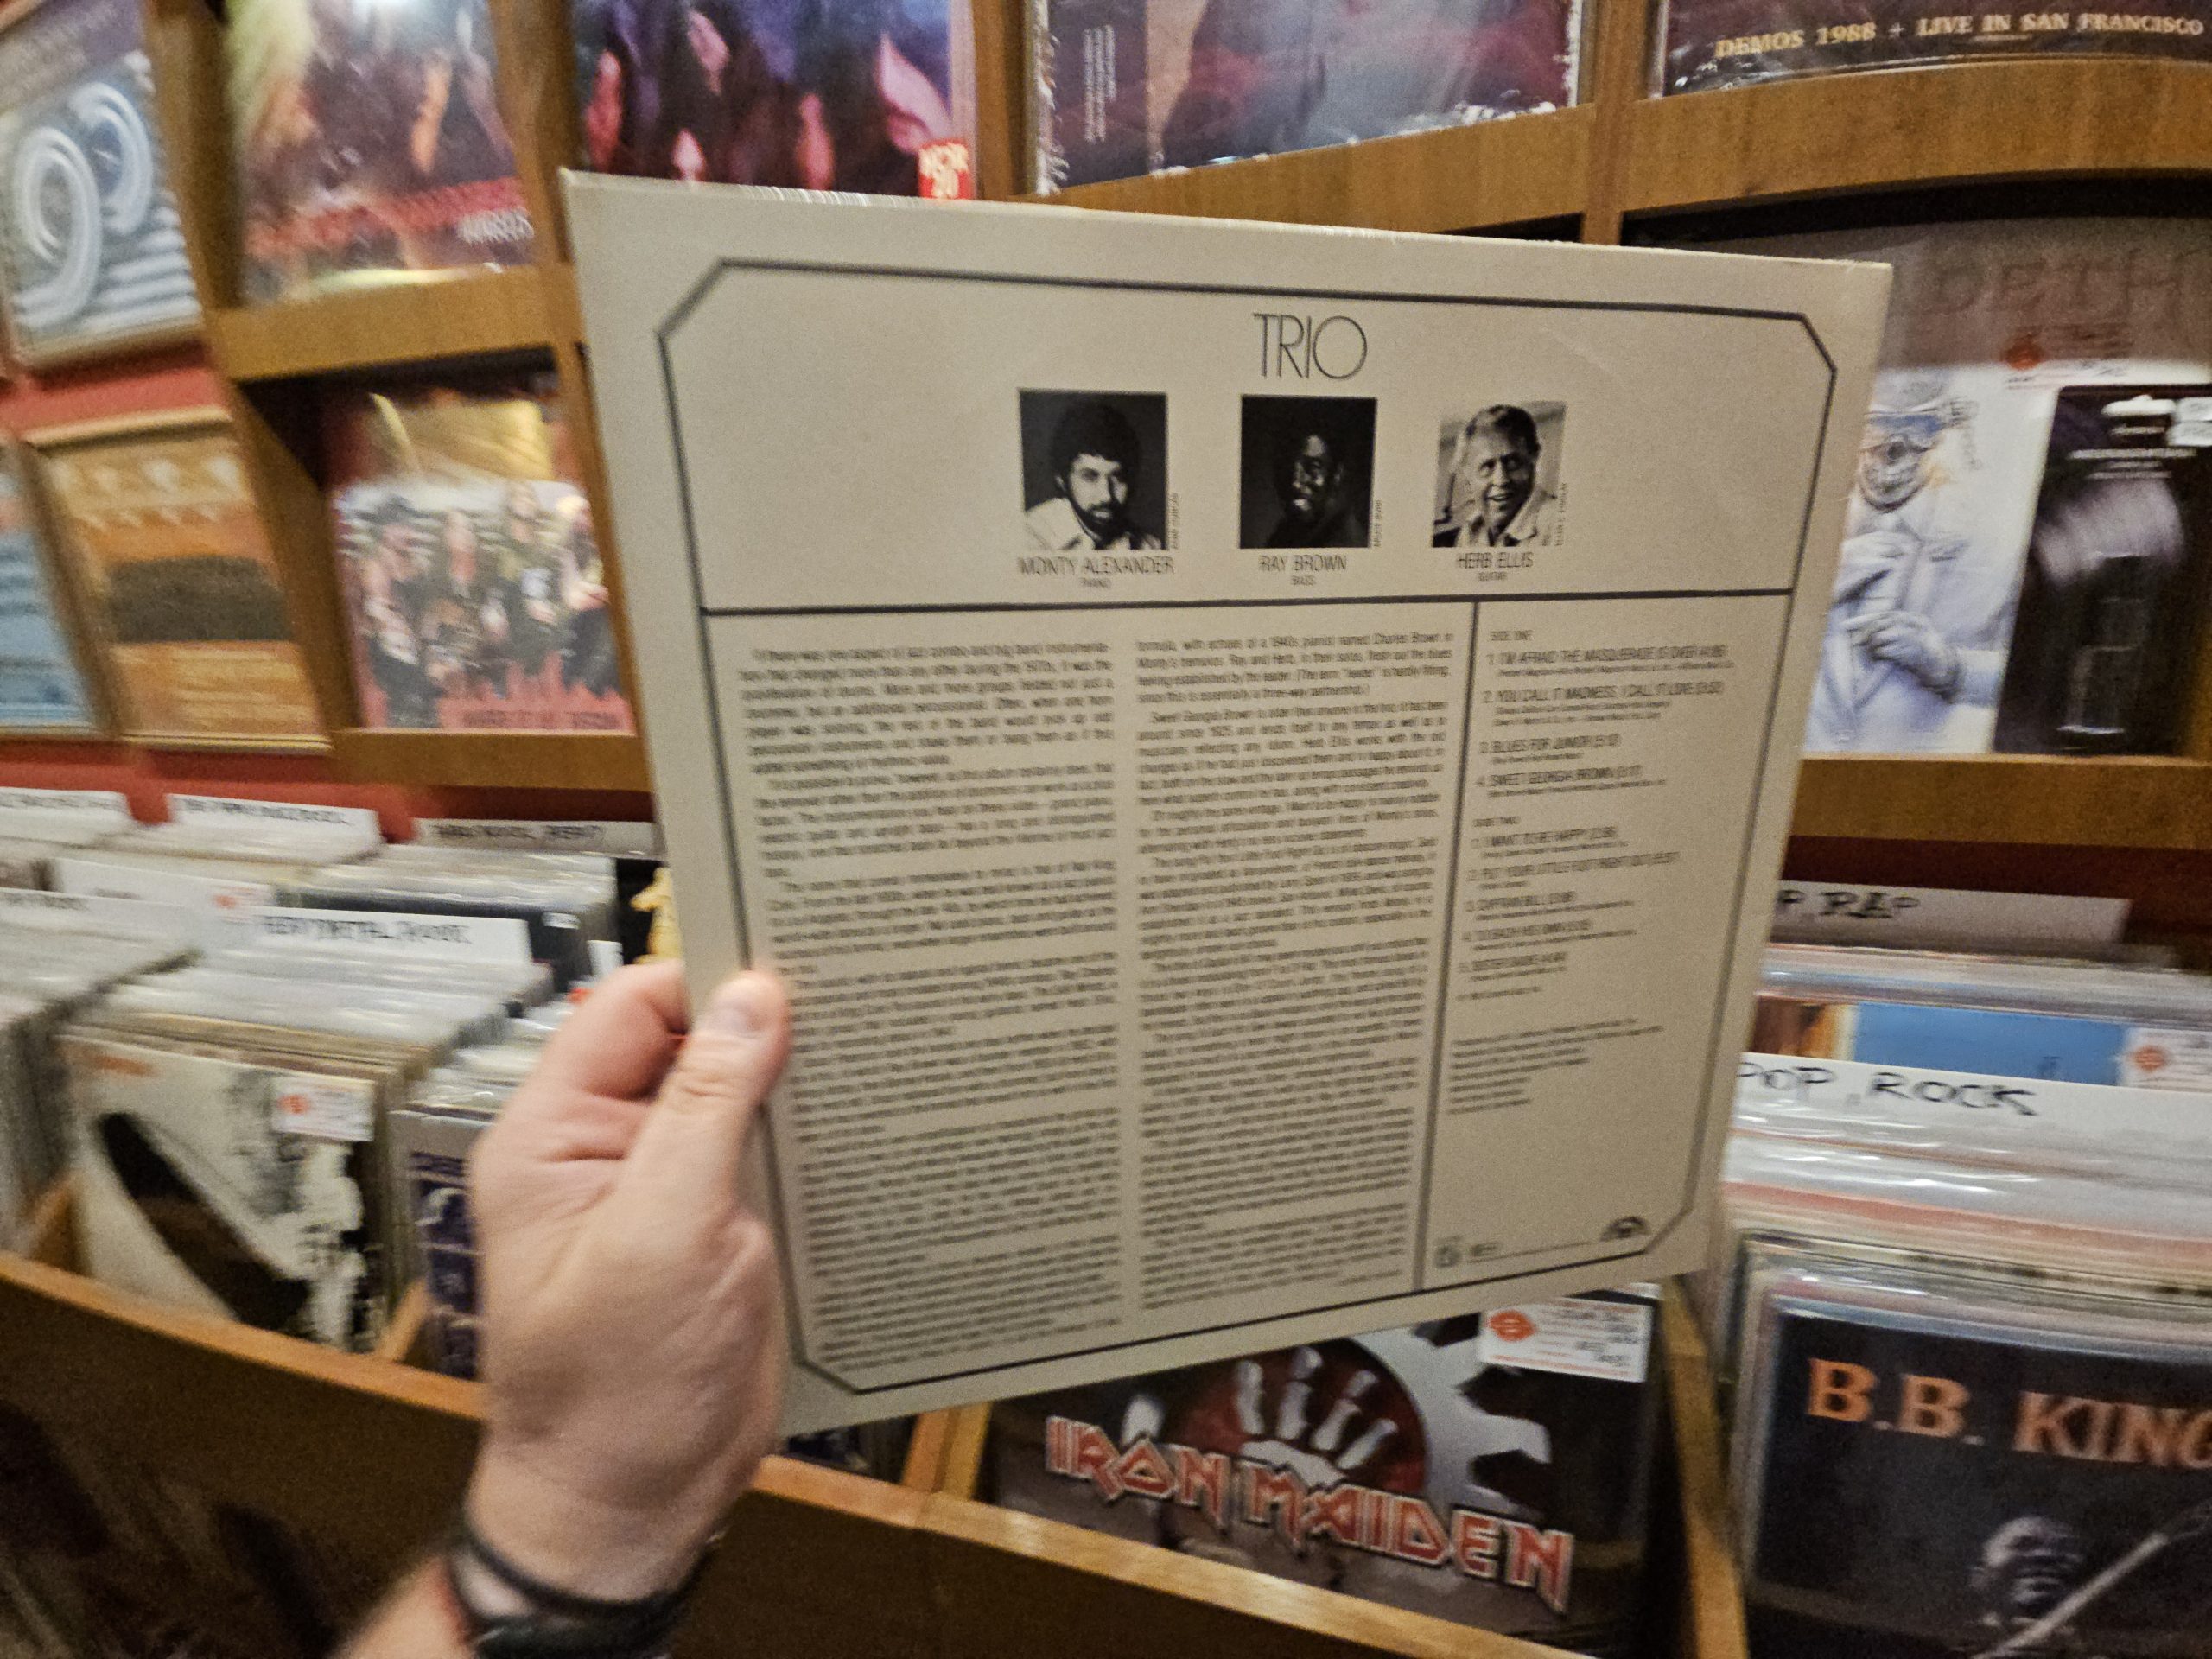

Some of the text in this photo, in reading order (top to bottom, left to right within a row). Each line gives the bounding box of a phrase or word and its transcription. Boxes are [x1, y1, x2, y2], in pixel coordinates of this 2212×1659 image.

[1714, 30, 1804, 58] DEMOS
[1815, 23, 1876, 45] 1988
[1916, 16, 1973, 36] LIVE
[1982, 14, 2011, 33] IN
[2020, 13, 2069, 32] SAN
[2076, 13, 2203, 35] FRANCISCO
[1253, 313, 1367, 379] TRIO
[1018, 556, 1175, 575] MONTY ALEXANDER
[1259, 554, 1347, 571] RAY BROWN
[1457, 552, 1534, 569] HERB ELLIS
[1868, 1072, 2036, 1116] ROCK
[1807, 1357, 1983, 1446] B.B.
[1045, 1415, 1574, 1614] IRON MAIDEN
